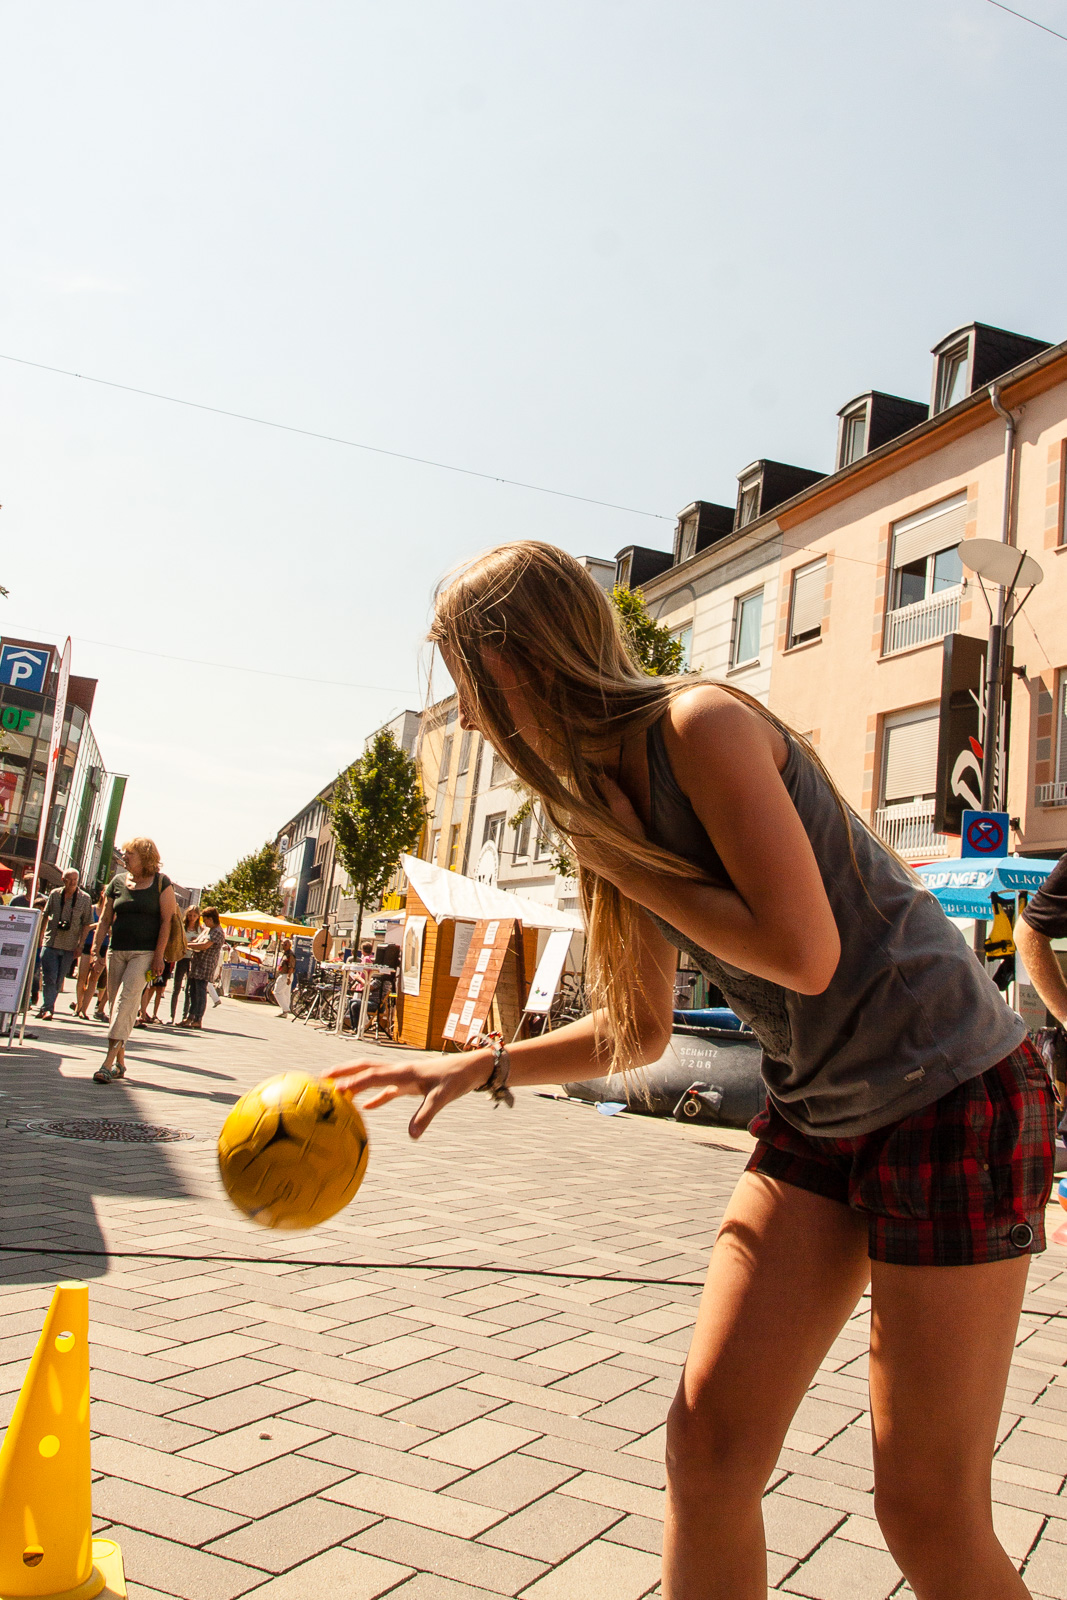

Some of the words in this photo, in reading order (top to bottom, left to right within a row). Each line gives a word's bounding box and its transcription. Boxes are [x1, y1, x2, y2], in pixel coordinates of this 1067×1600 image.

[10, 661, 33, 686] P
[0, 706, 35, 732] OF
[680, 1047, 718, 1058] SCHMITZ
[680, 1059, 711, 1069] 7206
